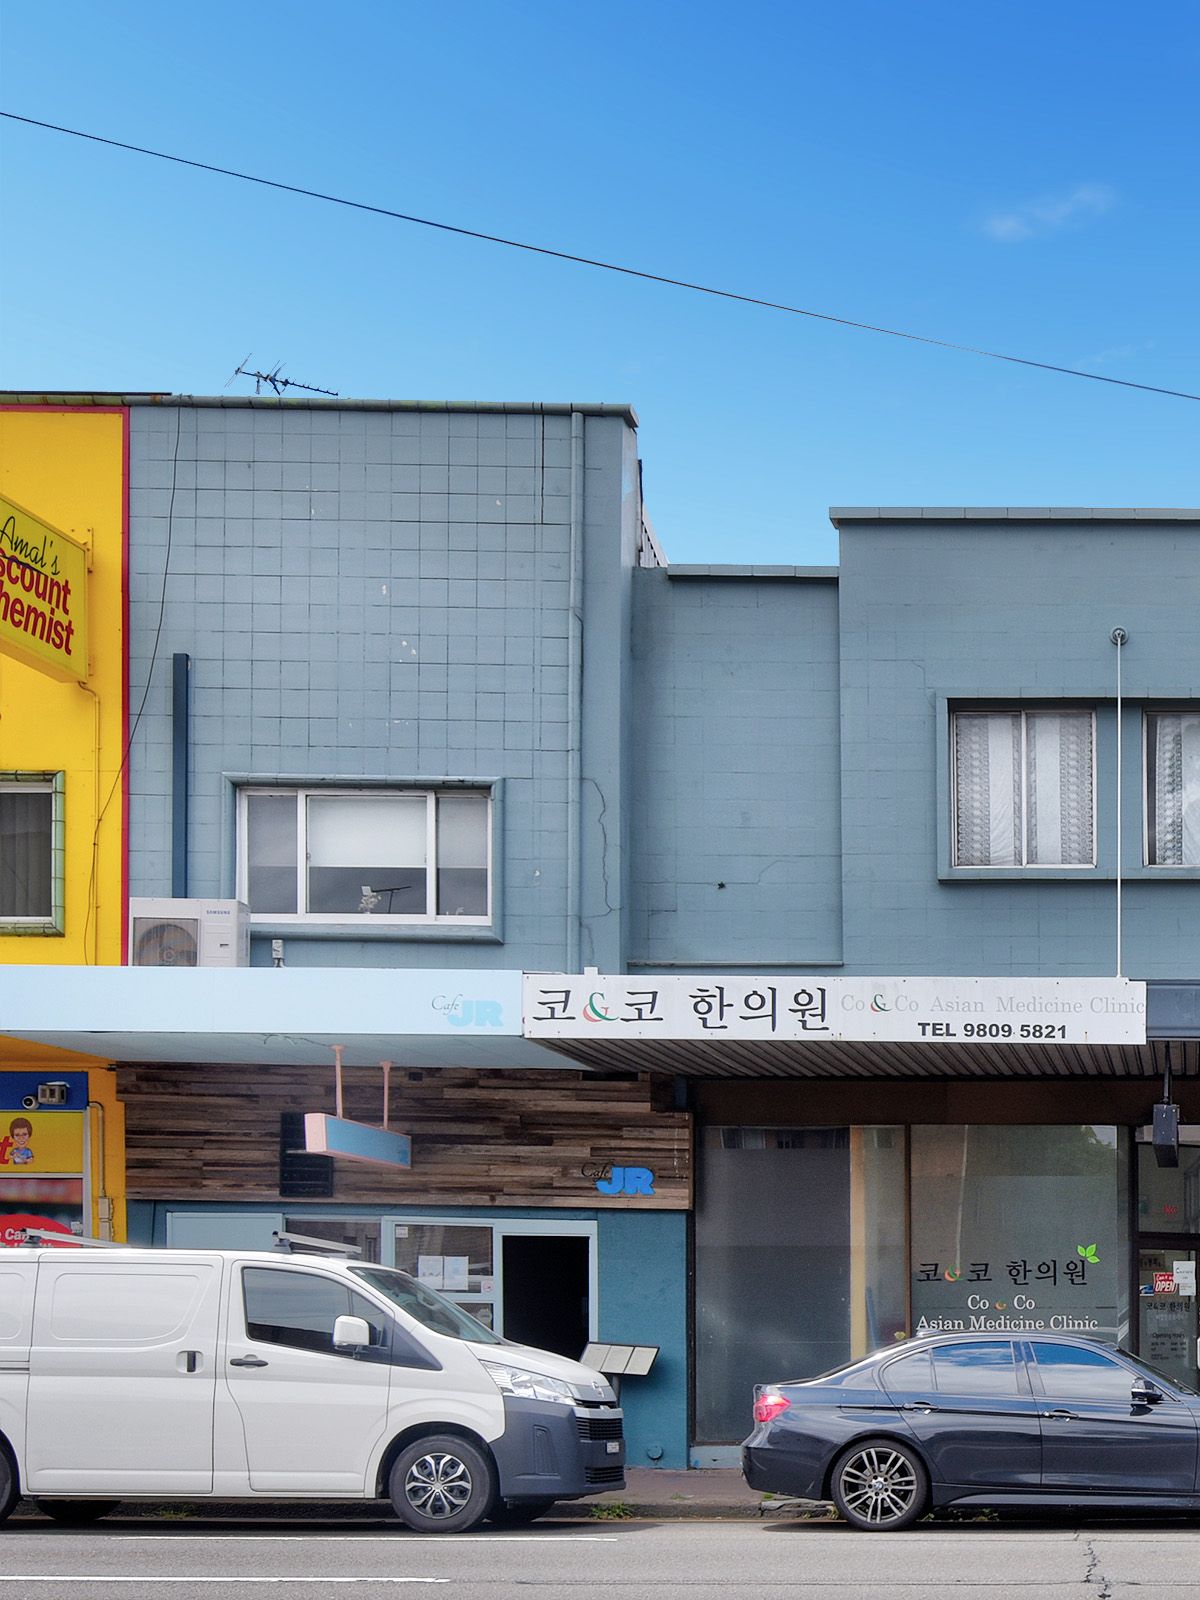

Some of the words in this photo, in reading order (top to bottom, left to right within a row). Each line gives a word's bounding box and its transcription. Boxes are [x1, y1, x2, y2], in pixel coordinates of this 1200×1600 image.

[0, 516, 60, 575] Amal's
[431, 993, 463, 1015] Cafe
[447, 1000, 504, 1027] JR
[688, 984, 830, 1033] 한의원
[840, 994, 865, 1012] Co
[894, 995, 919, 1013] Co
[930, 996, 985, 1014] Asian
[996, 996, 1083, 1015] Medicine
[1089, 996, 1145, 1015] Clinic
[918, 1022, 957, 1037] TEL
[963, 1022, 1013, 1039] 9809
[1019, 1023, 1068, 1040] 5821
[595, 1166, 656, 1195] JR
[1005, 1259, 1088, 1286] 한의원
[1155, 1280, 1175, 1292] OPEN
[967, 1295, 990, 1310] Co
[1013, 1295, 1036, 1310] Co
[916, 1315, 965, 1331] Asian
[969, 1315, 1045, 1331] Medicine
[1050, 1315, 1098, 1330] Clinic
